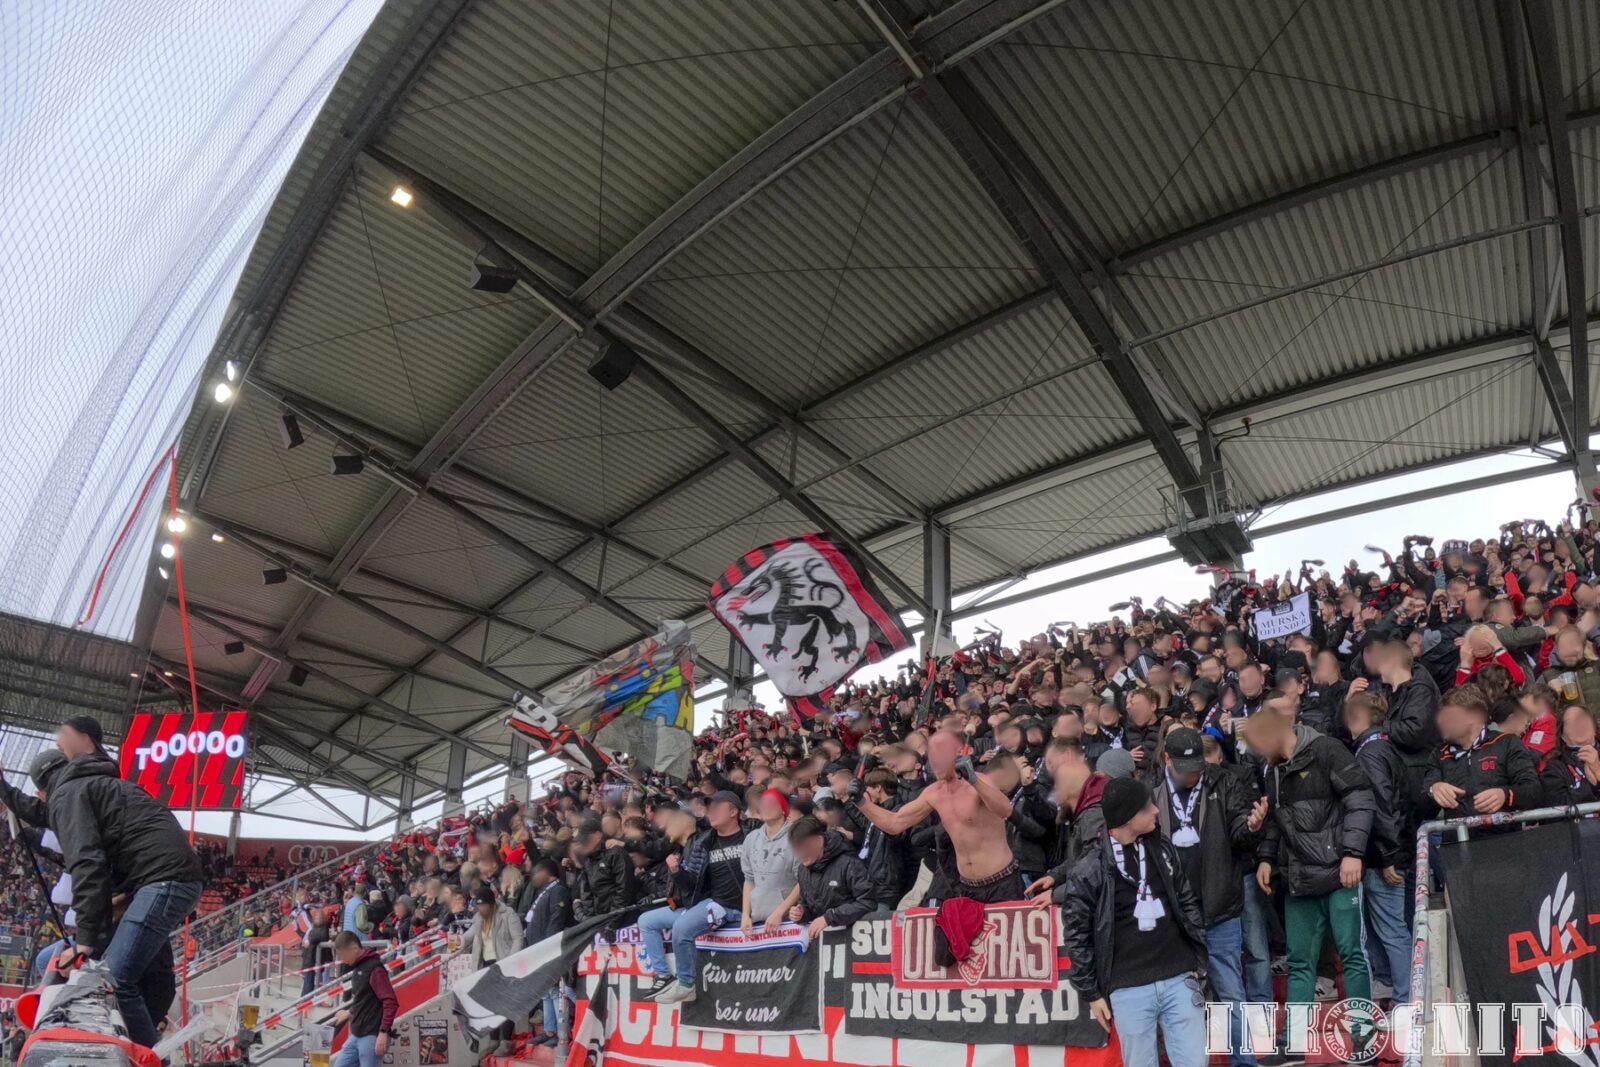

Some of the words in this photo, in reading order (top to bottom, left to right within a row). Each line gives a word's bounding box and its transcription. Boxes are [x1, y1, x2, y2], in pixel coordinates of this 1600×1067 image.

[1259, 617, 1307, 636] OFFENDER
[135, 731, 245, 770] TOOOOO
[904, 910, 1051, 980] ULRAS
[702, 961, 732, 992] für
[734, 964, 796, 984] immer
[715, 999, 742, 1021] bei
[745, 1005, 781, 1022] uns
[850, 980, 1098, 1025] INGOLSTAD
